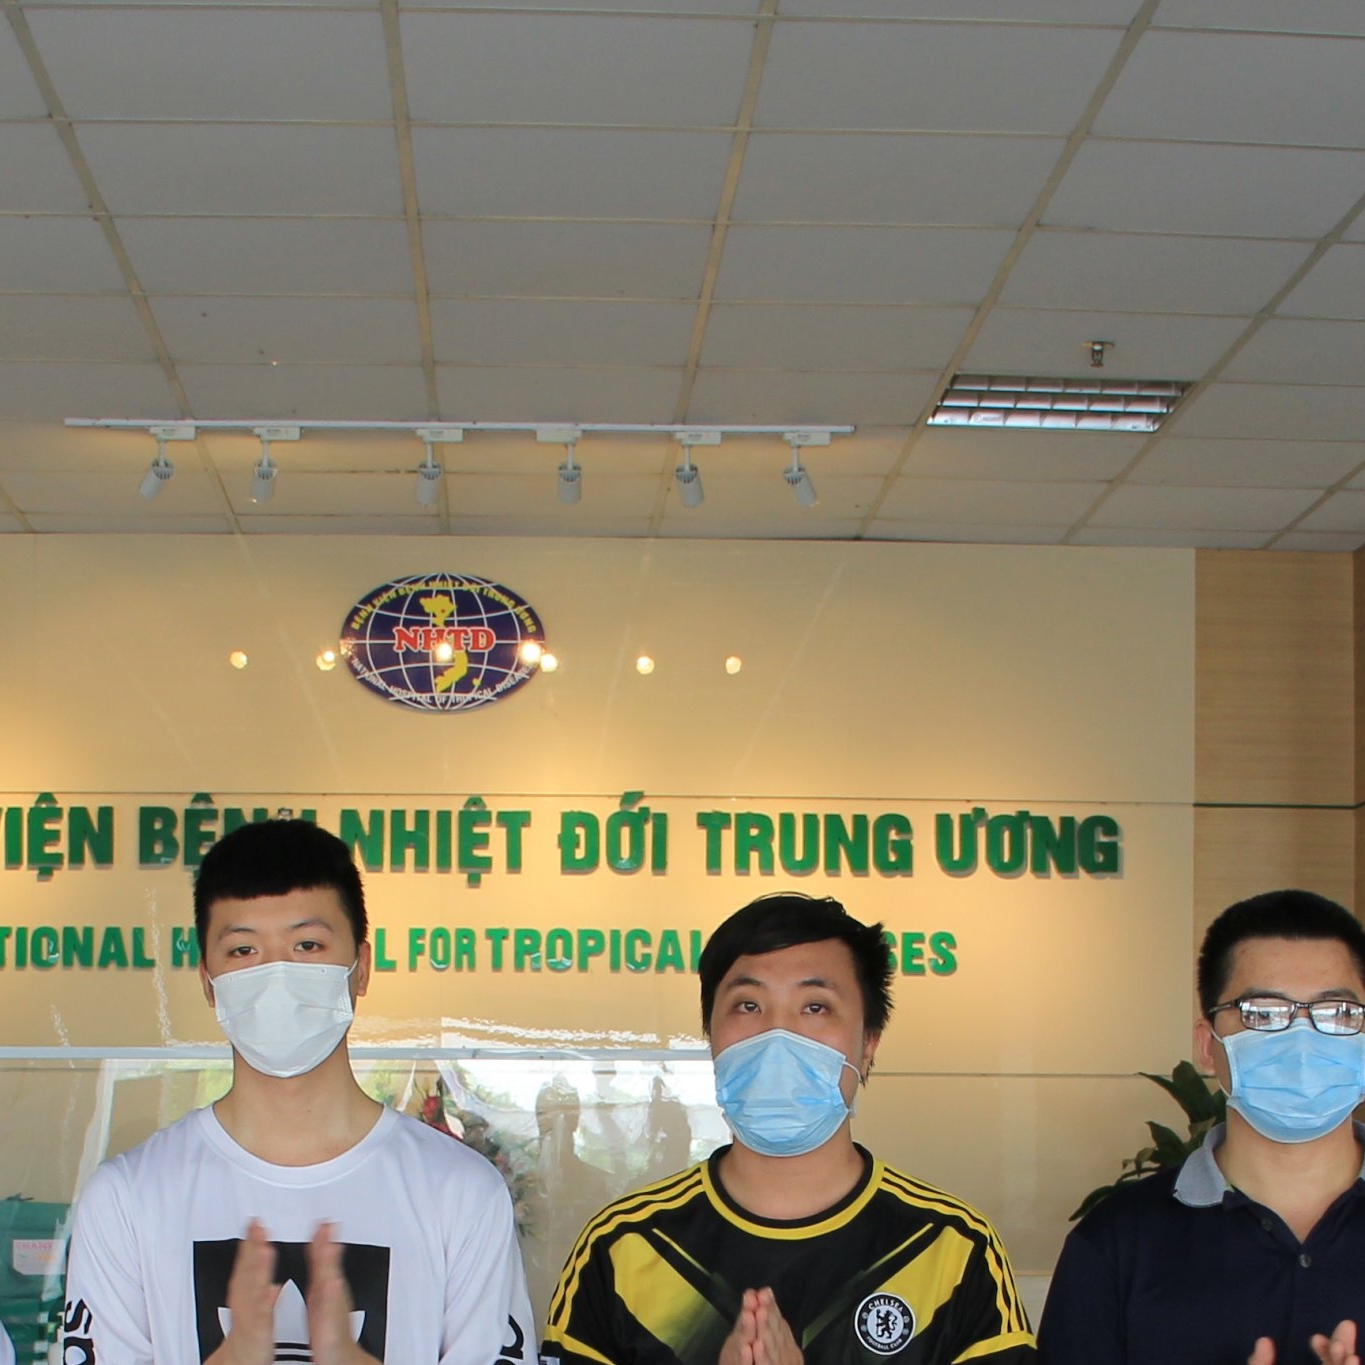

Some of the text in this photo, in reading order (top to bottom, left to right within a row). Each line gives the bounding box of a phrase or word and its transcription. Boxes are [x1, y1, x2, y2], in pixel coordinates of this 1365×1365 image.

[393, 626, 496, 653] NHTD
[138, 792, 317, 880] BỆ
[340, 796, 532, 887] NHIỆT
[557, 790, 668, 874] ĐỚI
[696, 810, 914, 875] TRUNG
[935, 806, 1120, 874] ƯƠNG
[408, 928, 476, 972] FOR
[868, 1298, 903, 1312] CHELSEA
